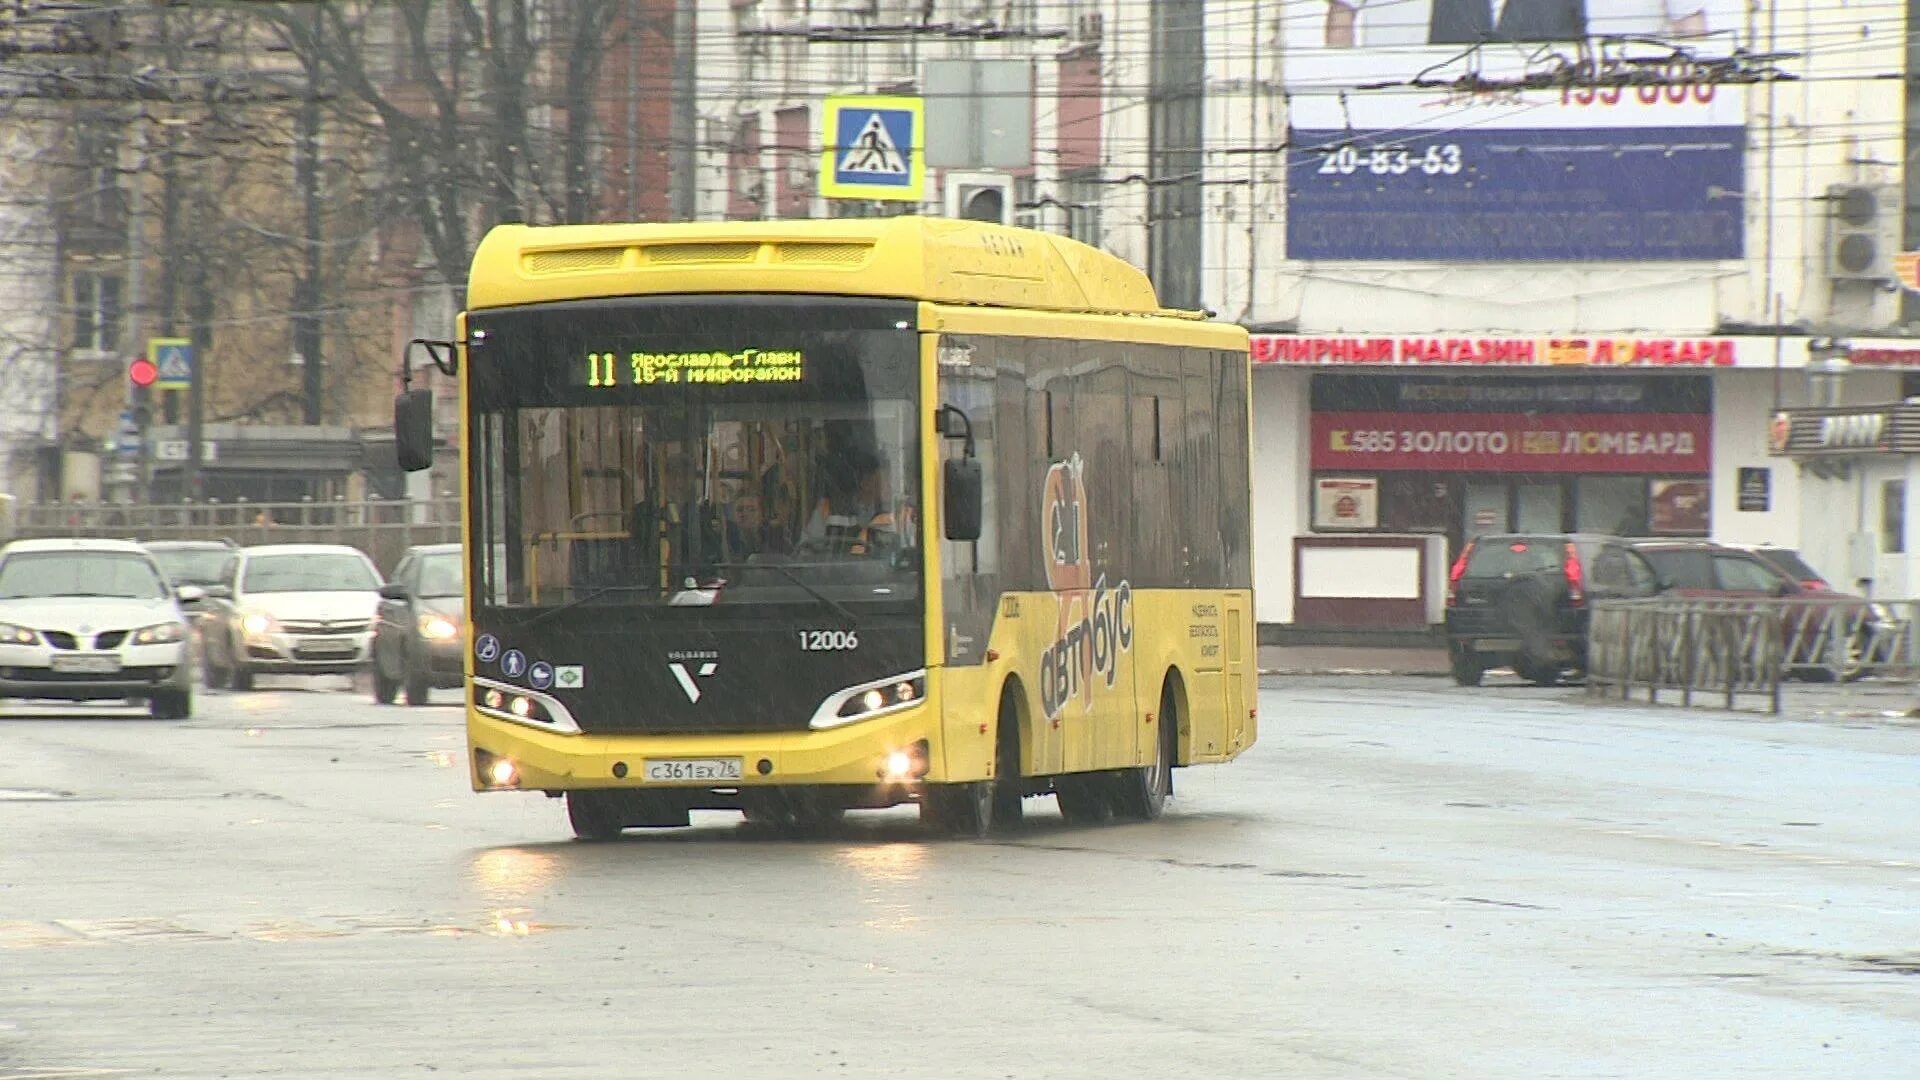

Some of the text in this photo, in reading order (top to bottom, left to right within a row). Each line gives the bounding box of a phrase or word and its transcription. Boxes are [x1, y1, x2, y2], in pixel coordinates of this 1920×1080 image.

[1318, 144, 1462, 175] 20-83-63
[1250, 338, 1393, 362] ЕЛИРНЫЙ
[1400, 338, 1534, 362] МАГАЗИН
[1593, 339, 1736, 365] ЛОМБАРД
[588, 353, 616, 386] 11
[687, 367, 801, 384] микрорайон
[1400, 431, 1508, 454] ЗОЛОТО
[1563, 431, 1695, 455] ЛОМБАРД
[799, 631, 858, 650] 12006
